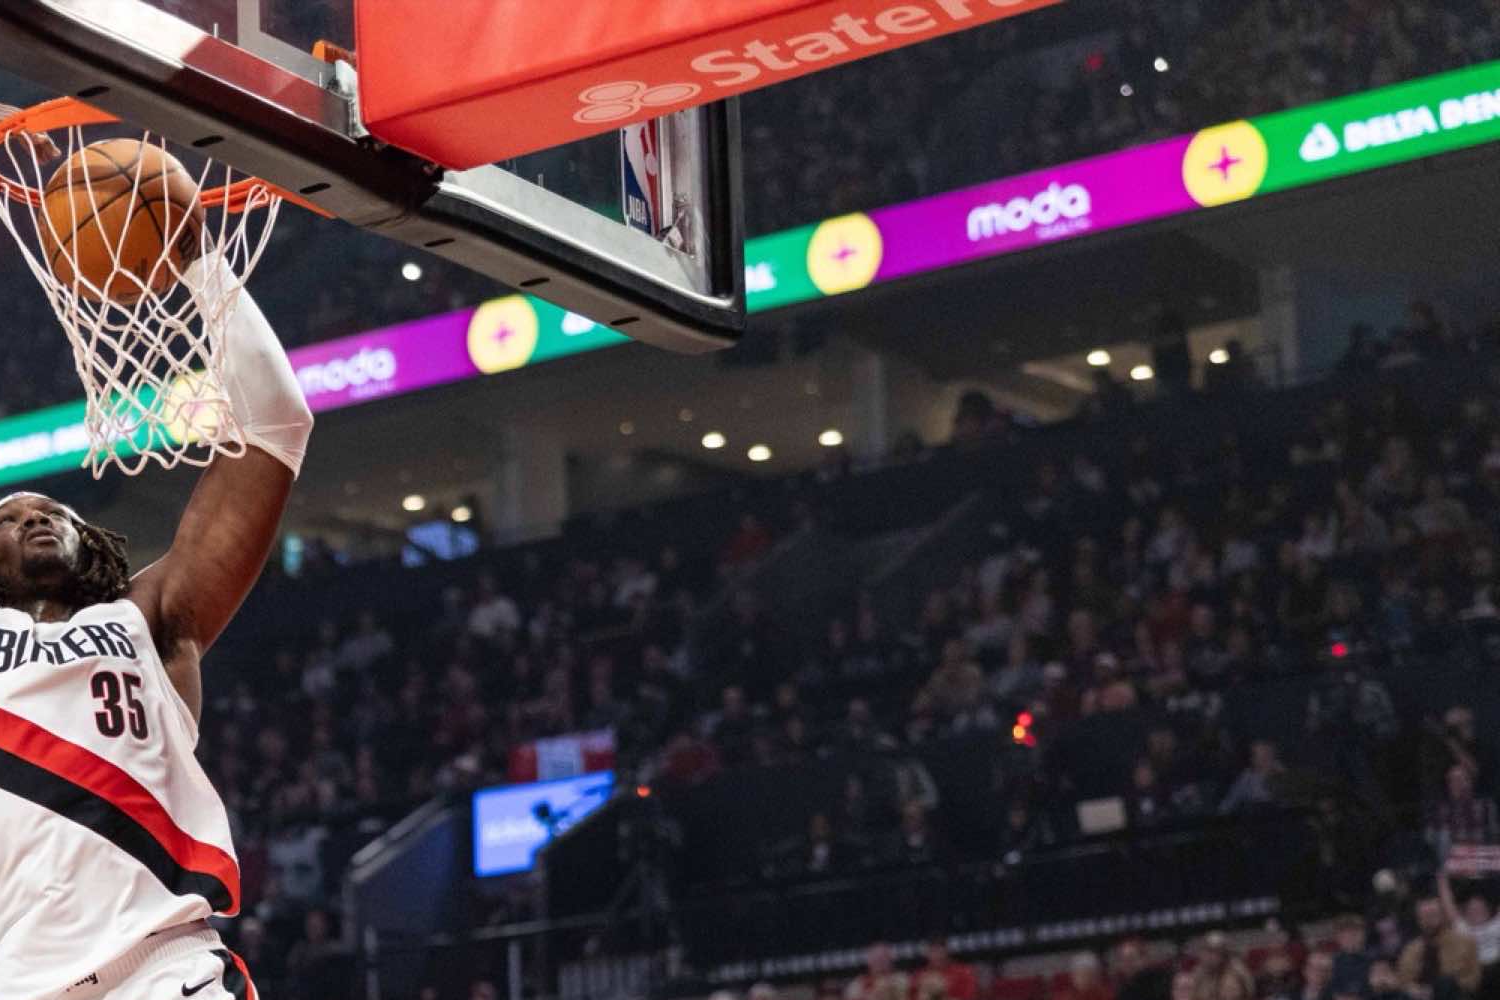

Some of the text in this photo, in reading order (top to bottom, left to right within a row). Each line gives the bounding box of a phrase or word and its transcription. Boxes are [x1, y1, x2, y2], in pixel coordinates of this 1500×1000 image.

[691, 0, 1022, 87] State
[967, 181, 1091, 241] moda
[90, 670, 150, 740] 35
